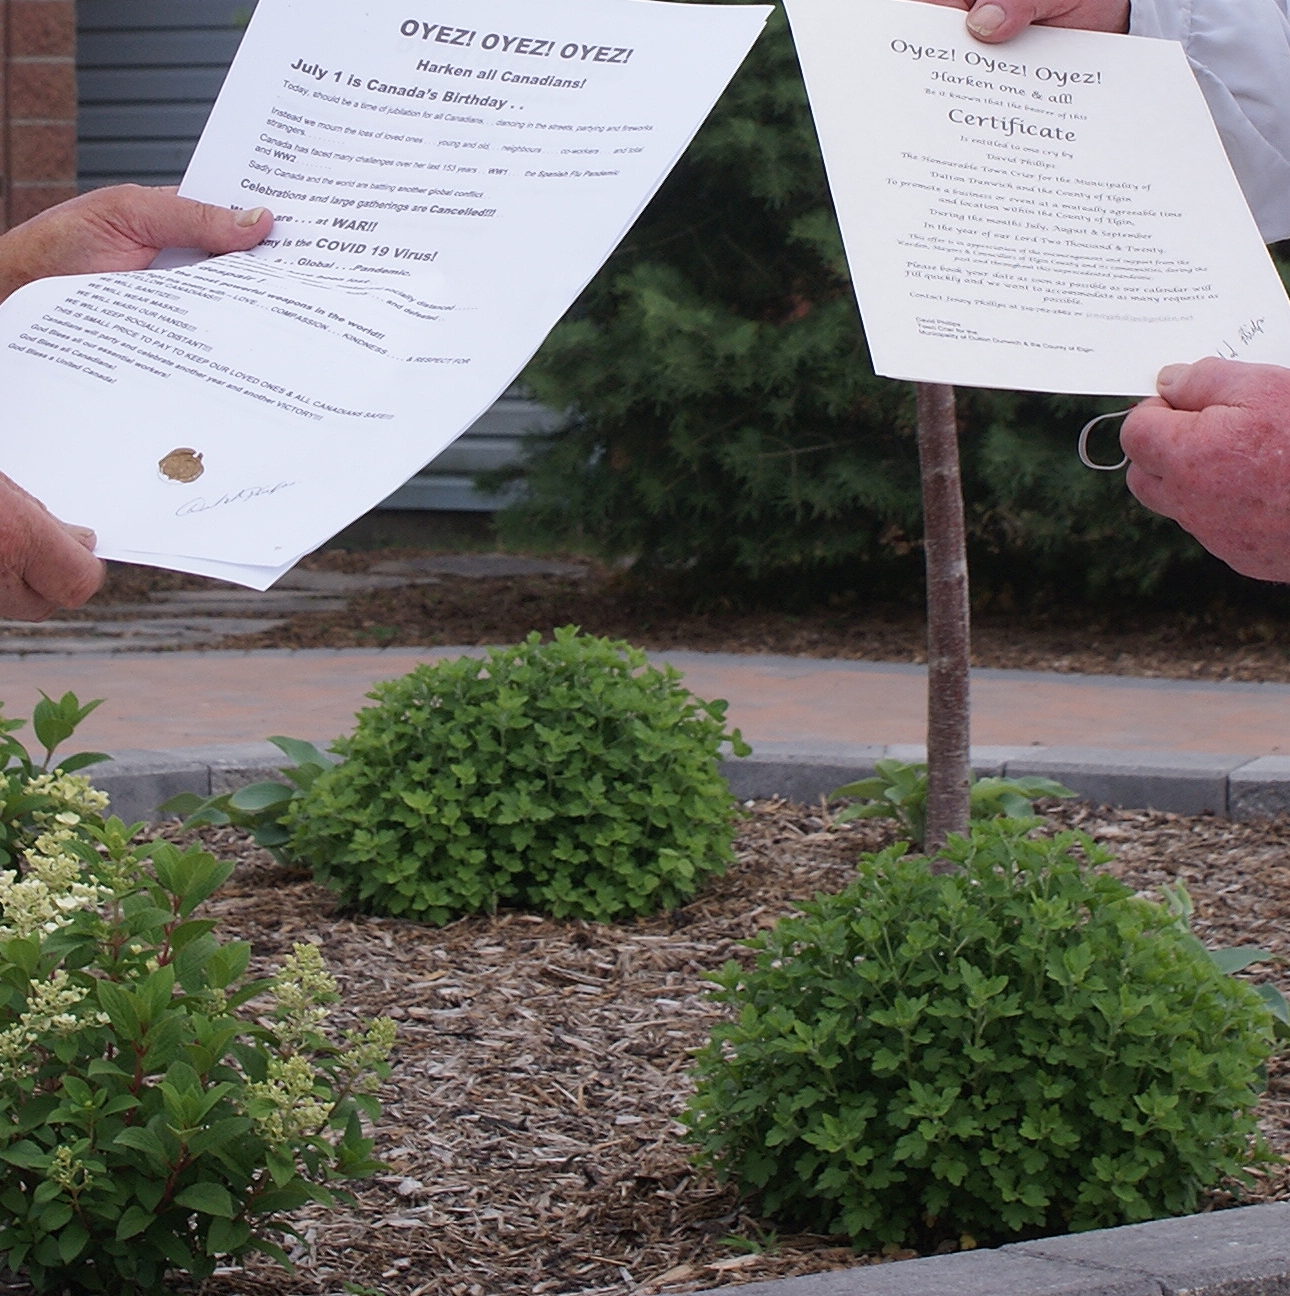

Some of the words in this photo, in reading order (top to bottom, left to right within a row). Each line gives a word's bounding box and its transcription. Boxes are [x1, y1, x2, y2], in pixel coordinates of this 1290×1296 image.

[400, 19, 476, 47] OYEZ!
[481, 33, 556, 56] OYEZ!
[560, 43, 634, 64] OYEZ!
[416, 59, 472, 77] Harken
[477, 69, 497, 80] all
[501, 71, 587, 89] Canadians!
[891, 39, 956, 61] Oyez!
[964, 52, 1027, 77] Oyez!
[1035, 67, 1102, 87] Oyez!
[283, 80, 310, 97] Today,
[313, 92, 340, 104] should
[342, 99, 352, 107] be
[361, 102, 377, 111] time
[387, 106, 421, 117] jubilation
[422, 111, 433, 119] for
[291, 59, 328, 80] July
[334, 71, 343, 82] 1
[347, 74, 361, 87] is
[367, 79, 438, 100] Canada's
[442, 91, 508, 110] Birthday
[930, 71, 994, 90] Harken
[999, 84, 1026, 96] one
[1031, 91, 1042, 100] &
[1048, 94, 1073, 104] all
[949, 92, 981, 103] known
[984, 96, 1003, 107] that
[1007, 101, 1022, 109] the
[1057, 111, 1067, 120] of
[1069, 113, 1087, 121] this
[271, 106, 302, 123] Instead
[318, 121, 343, 132] mourn
[344, 126, 356, 134] the
[358, 130, 373, 138] loss
[384, 133, 405, 142] loved
[948, 107, 1077, 142] Certificate
[255, 145, 271, 156] and
[273, 150, 296, 163] WW2
[260, 133, 292, 150] Canada
[295, 145, 308, 154] has
[311, 148, 332, 158] faced
[334, 151, 353, 163] many
[355, 156, 393, 166] challenges
[395, 160, 410, 168] over
[427, 162, 440, 170] last
[901, 152, 918, 160] The
[972, 137, 1008, 149] entitled
[1022, 146, 1039, 154] one
[1042, 149, 1059, 158] cry
[1062, 151, 1074, 159] by
[986, 153, 1017, 163] David
[1021, 159, 1056, 169] Phillips
[249, 160, 271, 175] Sadly
[274, 168, 305, 180] Canada
[307, 175, 320, 183] and
[322, 177, 334, 185] the
[335, 179, 355, 187] world
[398, 186, 427, 194] another
[428, 188, 453, 196] global
[241, 178, 307, 201] Celebrations
[309, 194, 328, 203] and
[330, 196, 355, 208] large
[357, 199, 409, 212] gatherings
[274, 214, 293, 222] are
[315, 218, 328, 226] at
[331, 218, 378, 232] WAR!!
[283, 239, 292, 247] is
[295, 239, 312, 247] the
[316, 238, 366, 254] COVID
[371, 245, 389, 257] 19
[394, 247, 438, 262] Virus!
[298, 257, 334, 269] Global
[138, 308, 157, 318] OUR
[219, 281, 266, 296] powerful
[267, 293, 313, 311] weapons
[315, 307, 325, 316] in
[329, 311, 346, 322] the
[386, 300, 403, 309] and
[79, 303, 99, 312] WILL
[101, 308, 124, 318] KEEP
[125, 315, 167, 334] SOCIALLY
[270, 306, 328, 330] COMPASSION
[342, 333, 388, 355] KINDNESS
[8, 342, 25, 352] God
[26, 348, 48, 359] Bless
[56, 357, 81, 370] United
[20, 333, 37, 342] God
[37, 338, 59, 349] Bless
[31, 324, 48, 332] God
[49, 329, 71, 339] Bless
[97, 346, 135, 363] essential
[42, 314, 82, 331] Canadians
[98, 333, 119, 344] party
[121, 342, 136, 350] and
[137, 348, 174, 366] celebrate
[175, 363, 207, 379] another
[206, 375, 225, 388] year
[226, 383, 243, 392] and
[243, 390, 275, 405] another
[54, 306, 72, 315] THIS
[83, 315, 110, 327] SMALL
[112, 324, 138, 338] PRICE
[140, 334, 152, 343] TO
[152, 340, 169, 351] PAY
[172, 347, 185, 356] TO
[186, 353, 210, 365] KEEP
[209, 362, 229, 373] OUR
[229, 368, 260, 385] LOVED
[260, 381, 286, 394] ONES
[286, 388, 294, 397] &
[295, 393, 312, 404] ALL
[313, 400, 364, 417] CANADIANS
